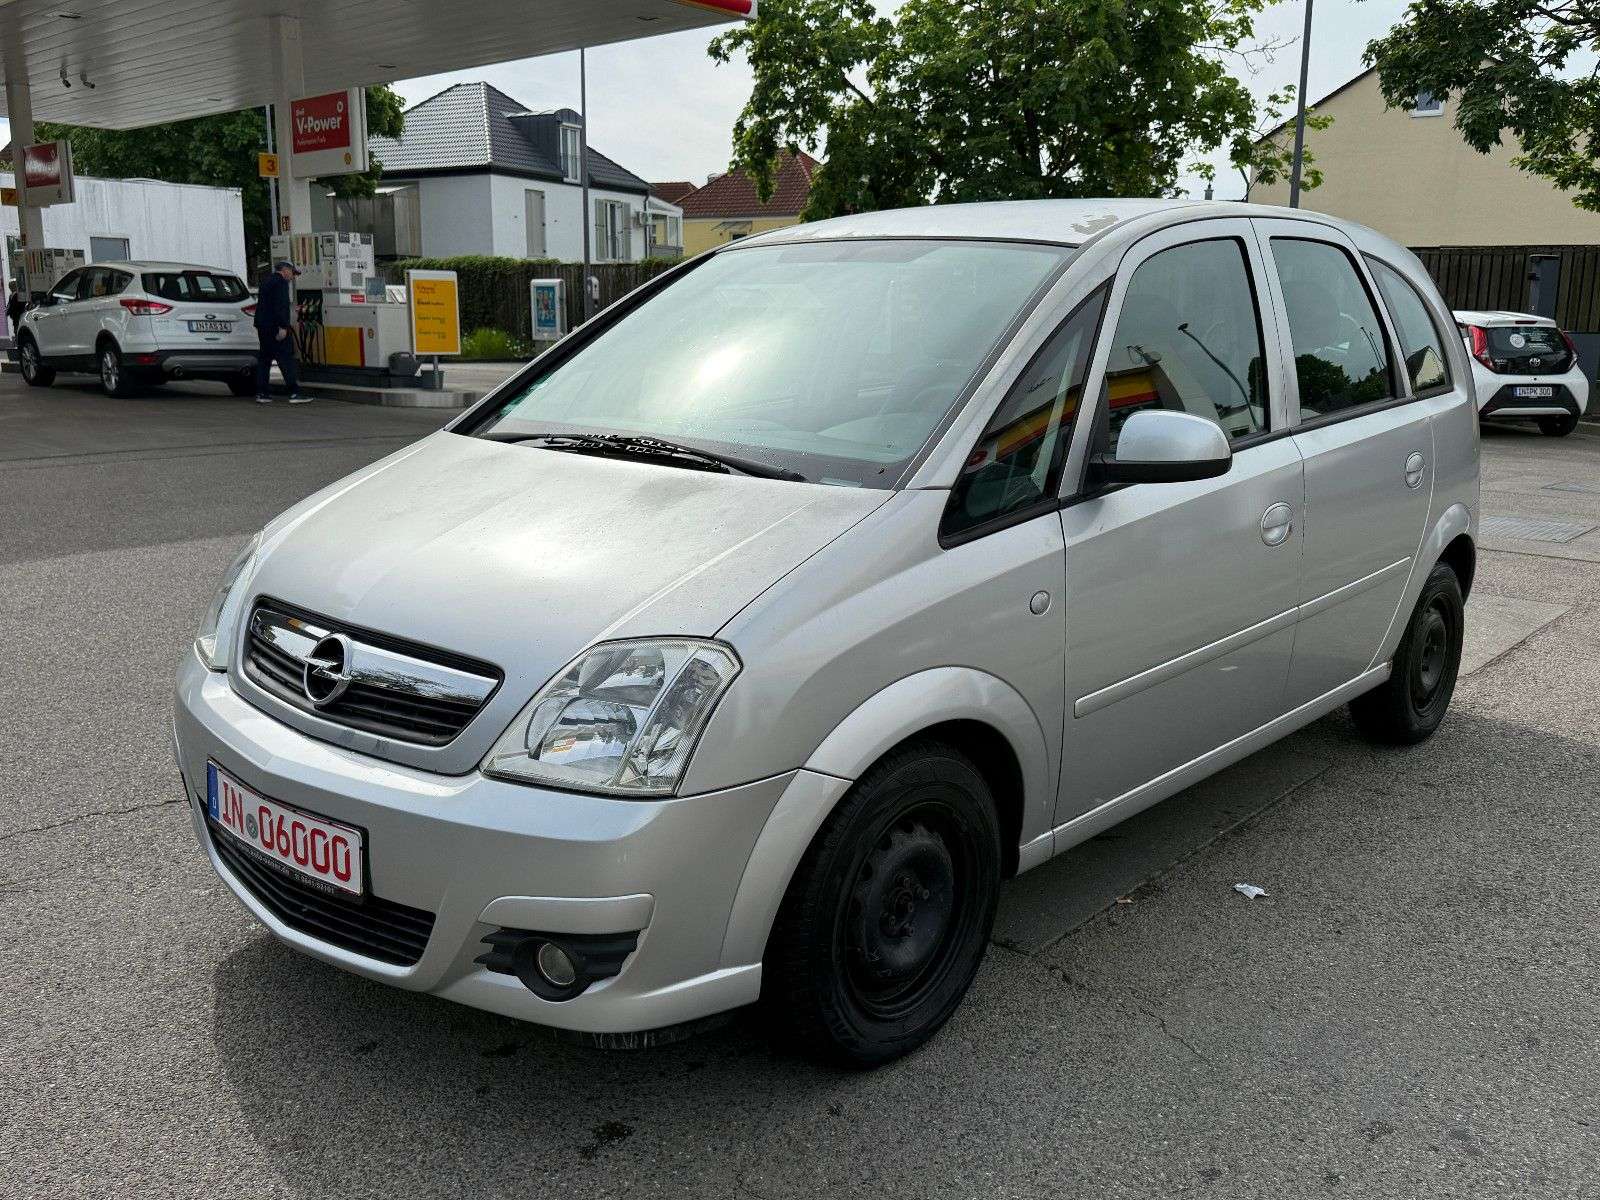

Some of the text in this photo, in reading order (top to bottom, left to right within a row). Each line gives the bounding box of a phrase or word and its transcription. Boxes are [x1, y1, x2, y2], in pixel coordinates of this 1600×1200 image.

[266, 159, 276, 173] 3
[222, 781, 245, 835] IN
[258, 805, 352, 883] 06000
